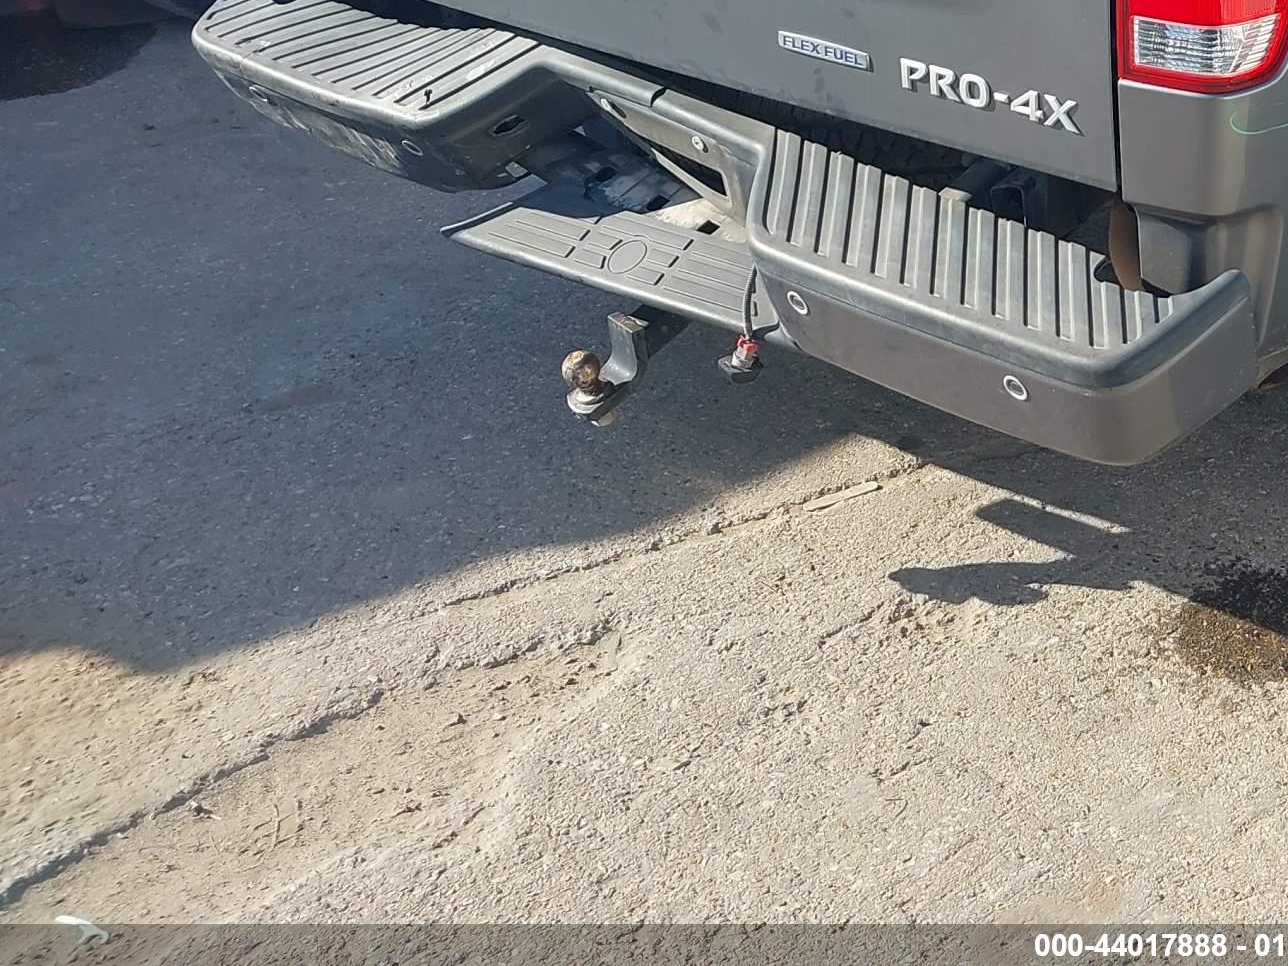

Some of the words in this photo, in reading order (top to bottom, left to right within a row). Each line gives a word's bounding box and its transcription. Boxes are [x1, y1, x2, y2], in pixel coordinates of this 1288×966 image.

[783, 35, 821, 55] FLEX
[823, 45, 865, 67] FUEL
[899, 56, 1084, 136] PRO-4X
